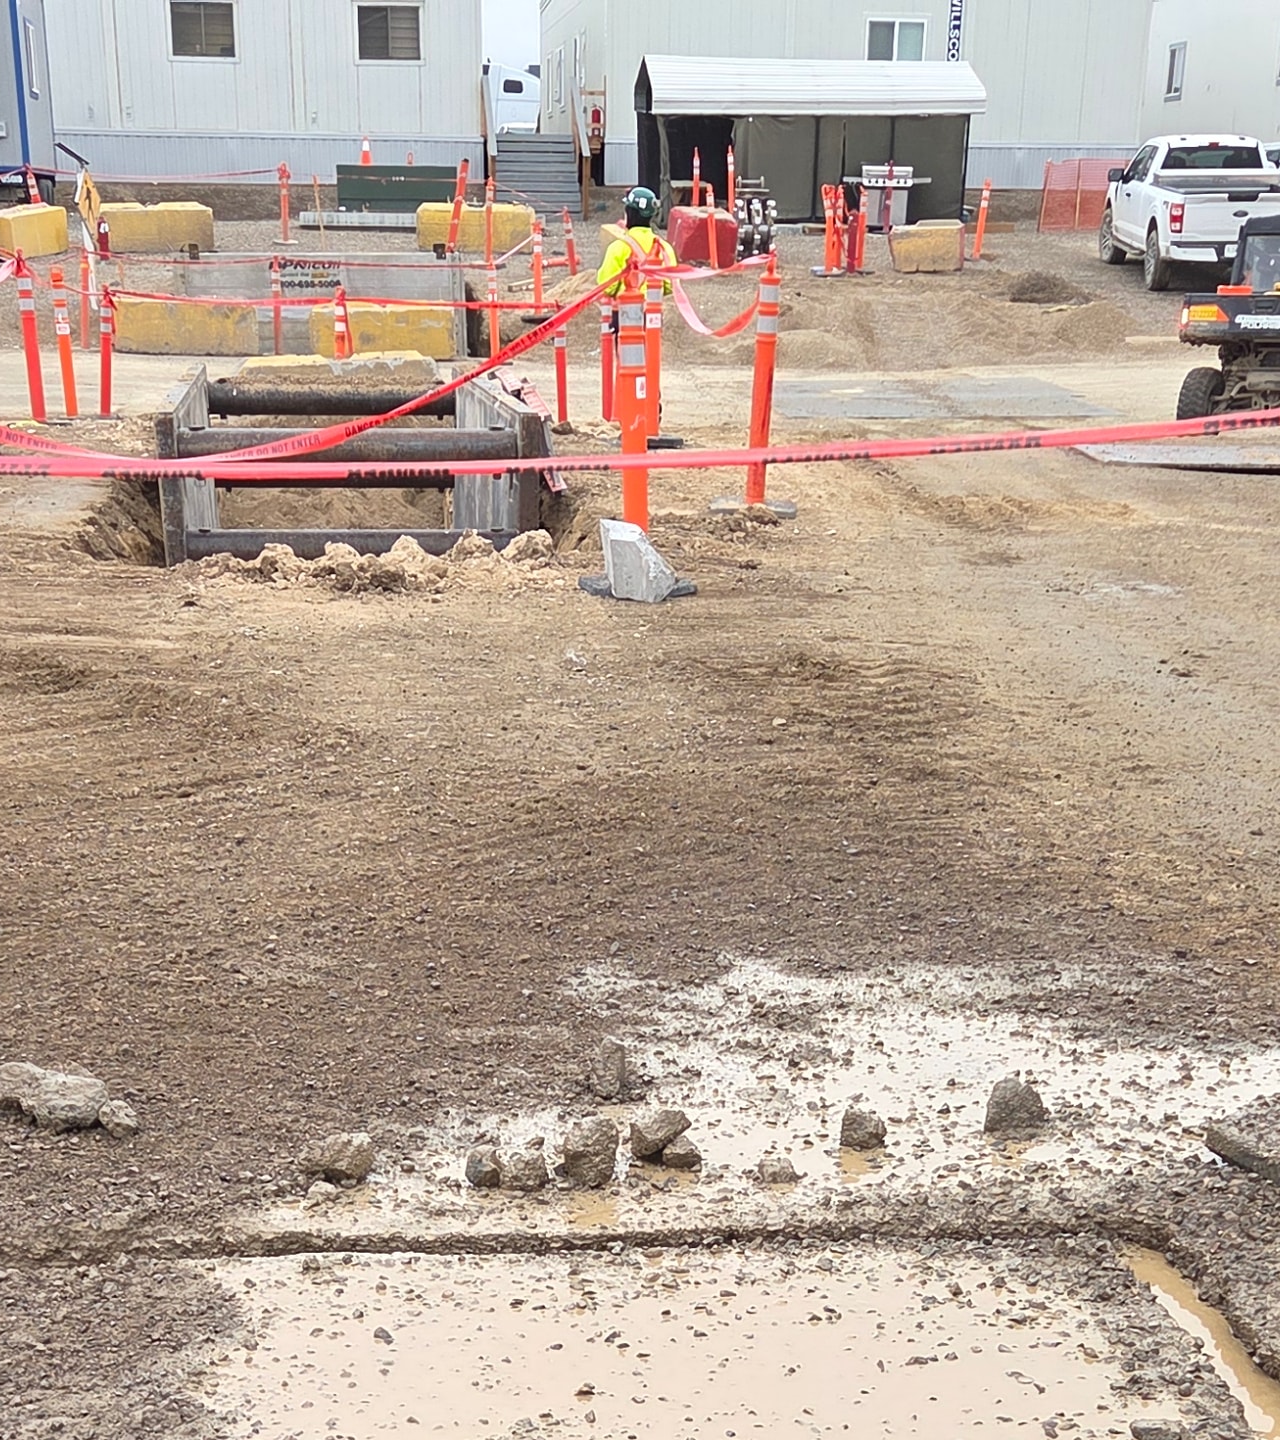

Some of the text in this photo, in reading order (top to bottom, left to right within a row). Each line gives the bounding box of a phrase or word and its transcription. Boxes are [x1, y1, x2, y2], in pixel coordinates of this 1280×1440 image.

[4, 430, 25, 444] NOT
[270, 442, 290, 454] NOT
[290, 433, 321, 450] ENTER
